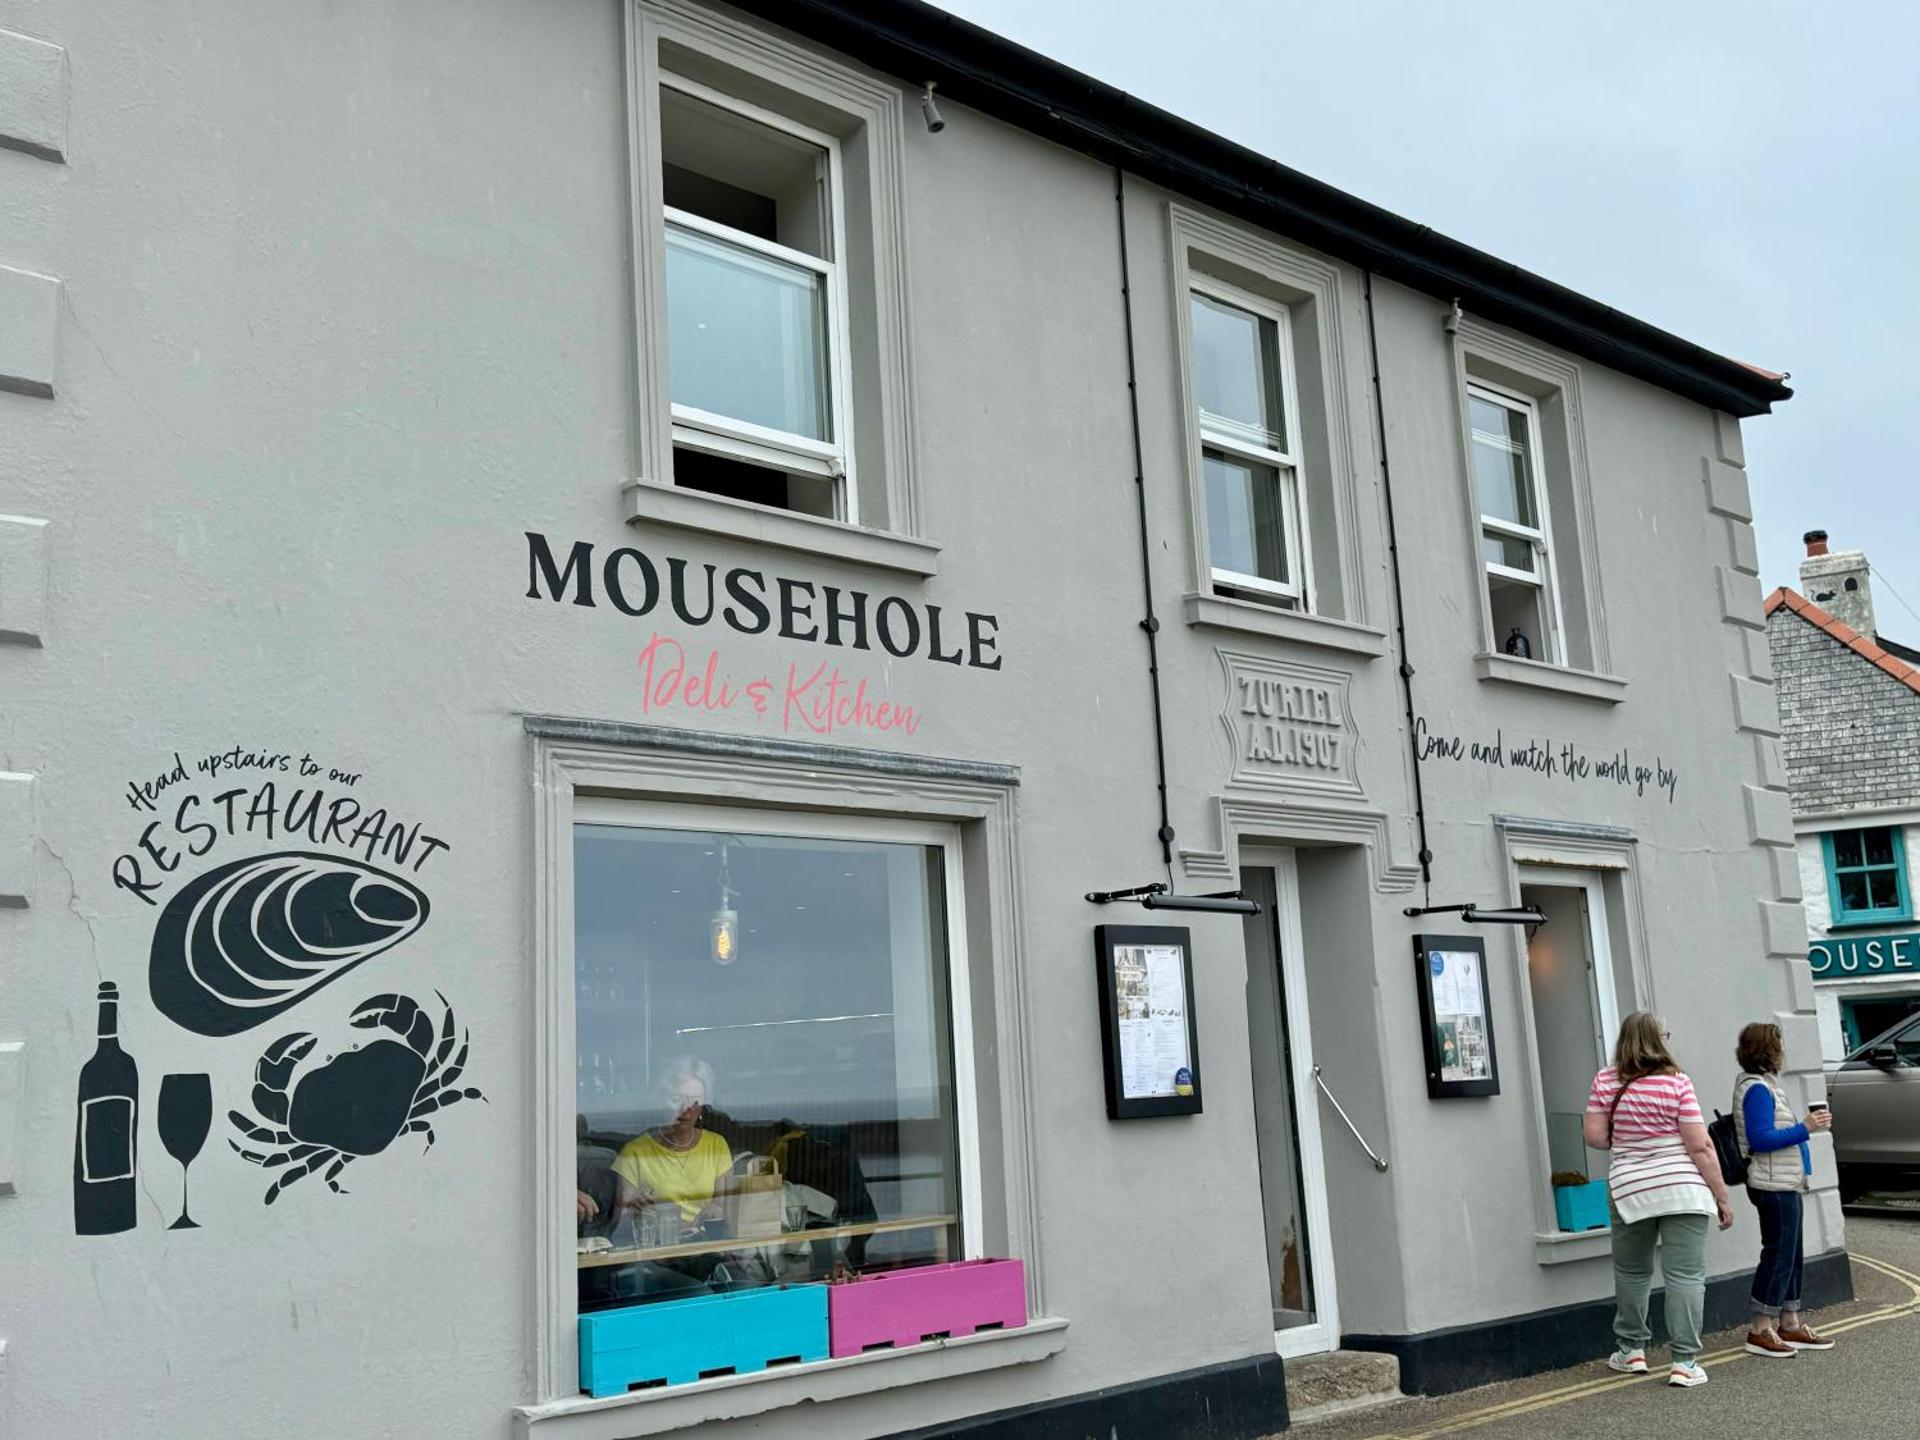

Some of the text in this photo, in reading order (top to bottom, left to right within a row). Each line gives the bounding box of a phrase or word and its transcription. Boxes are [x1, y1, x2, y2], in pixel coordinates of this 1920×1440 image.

[524, 531, 1002, 672] MOUSEHOLE
[637, 631, 921, 737] Deli & Kitchen
[1238, 677, 1342, 728] ZURIEL
[125, 745, 362, 812] Head upstairs to our
[1415, 716, 1678, 804] Come and watch the world go by
[112, 781, 451, 907] RESTAURANT
[1808, 938, 1920, 972] OUSE
